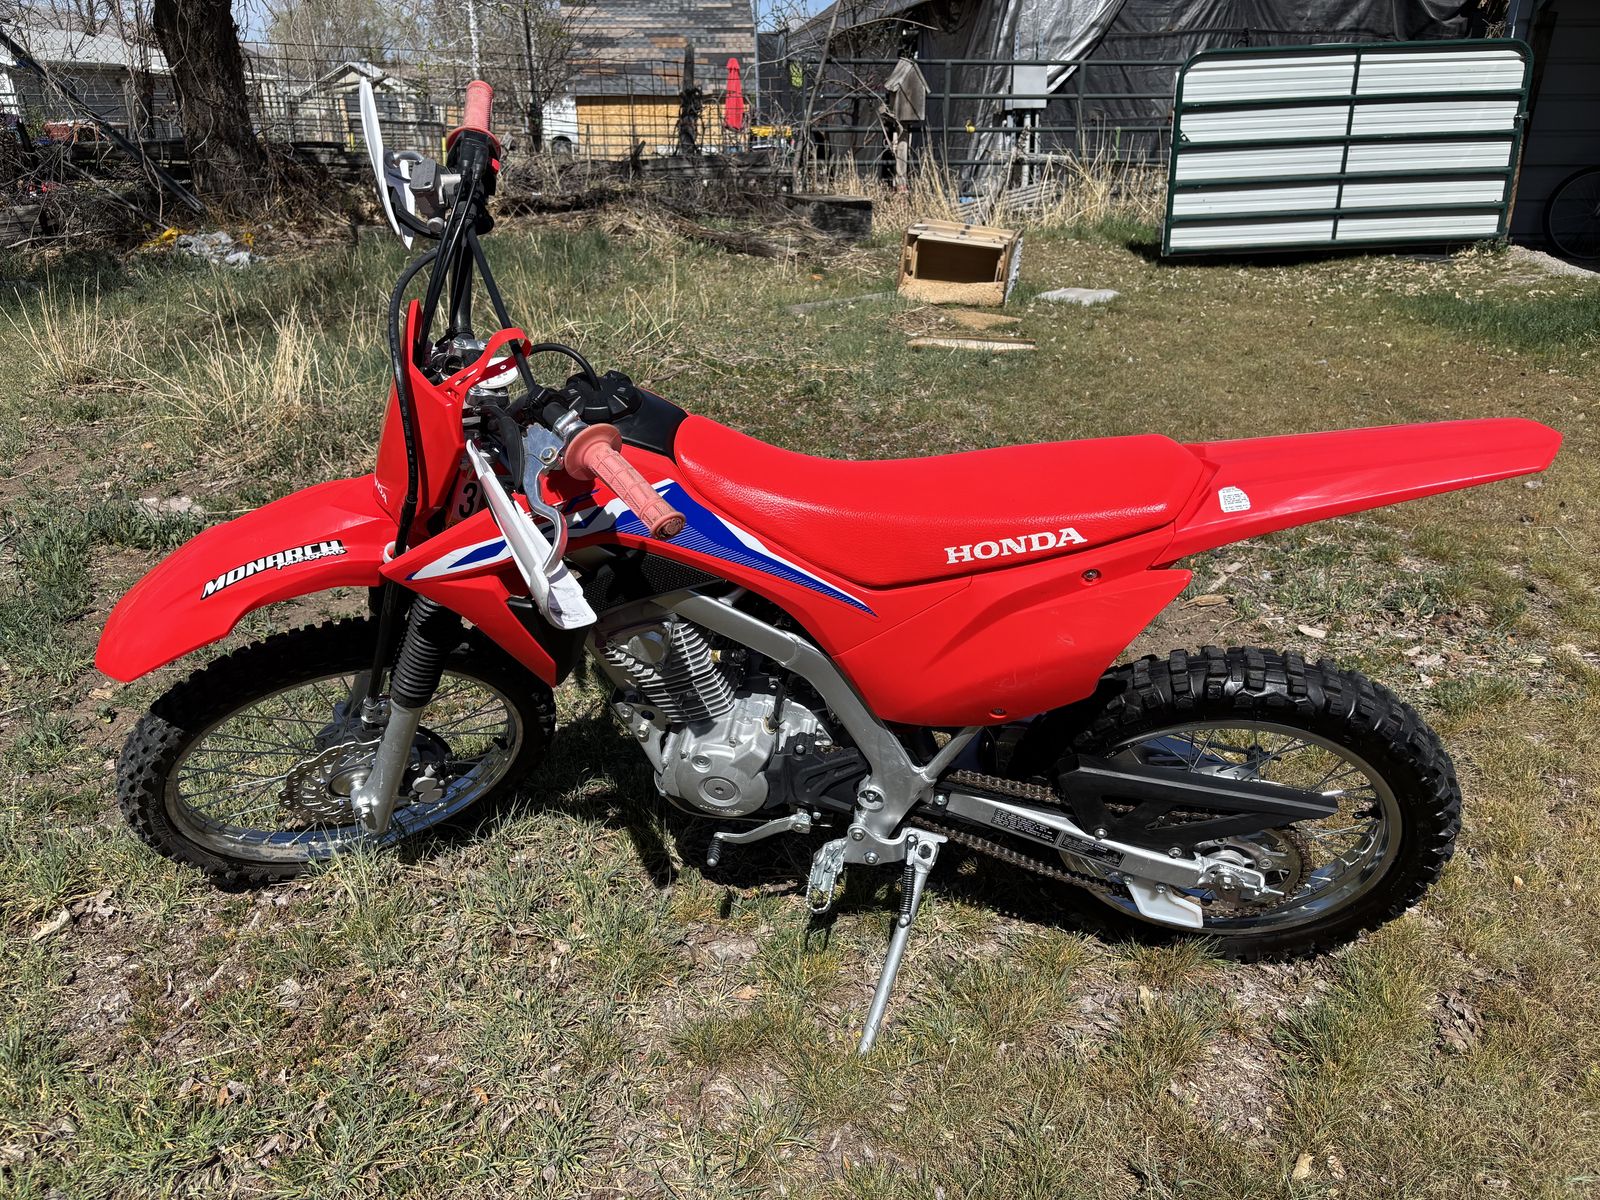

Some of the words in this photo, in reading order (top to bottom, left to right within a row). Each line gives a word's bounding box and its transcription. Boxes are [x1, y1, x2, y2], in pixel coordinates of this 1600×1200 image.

[458, 482, 478, 518] 3
[944, 527, 1088, 564] HONDA
[201, 540, 343, 599] MONARCH
